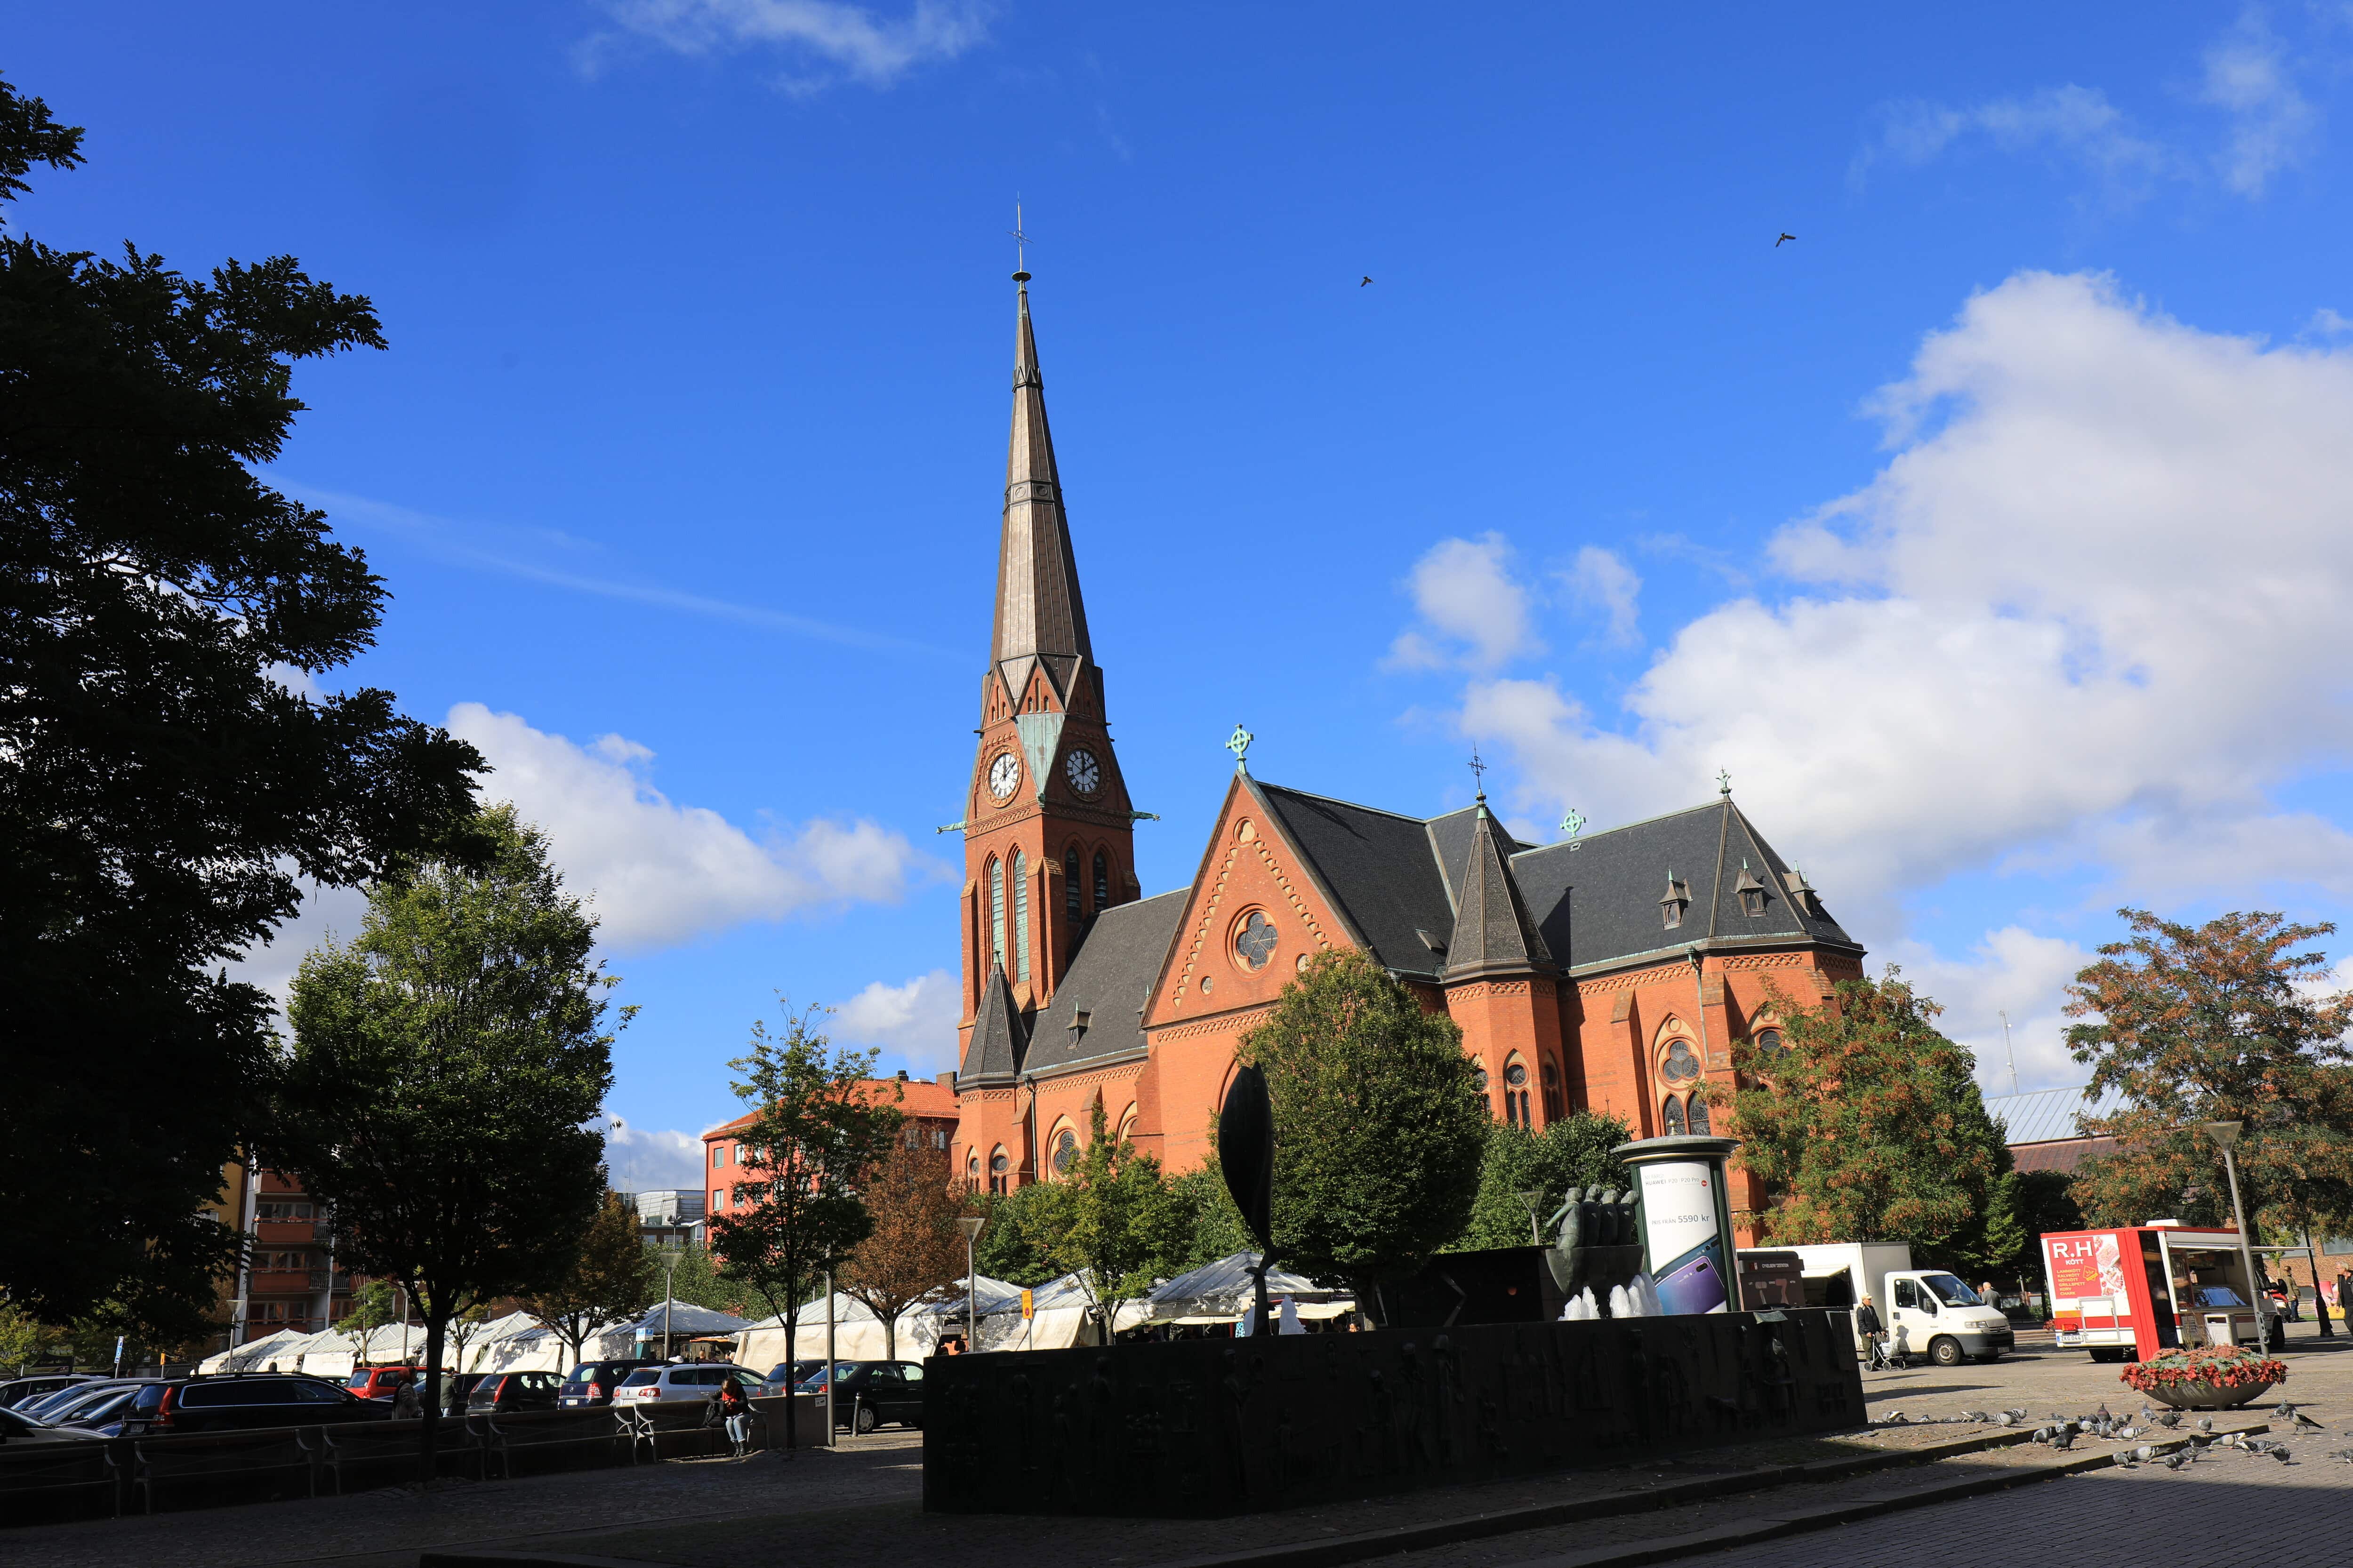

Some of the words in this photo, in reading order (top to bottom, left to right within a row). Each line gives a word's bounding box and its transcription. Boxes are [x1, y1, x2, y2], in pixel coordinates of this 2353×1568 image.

[1678, 1215, 1698, 1223] 5590
[1701, 1214, 1710, 1222] kr
[2052, 1241, 2094, 1259] R.H
[119, 1337, 122, 1346] P
